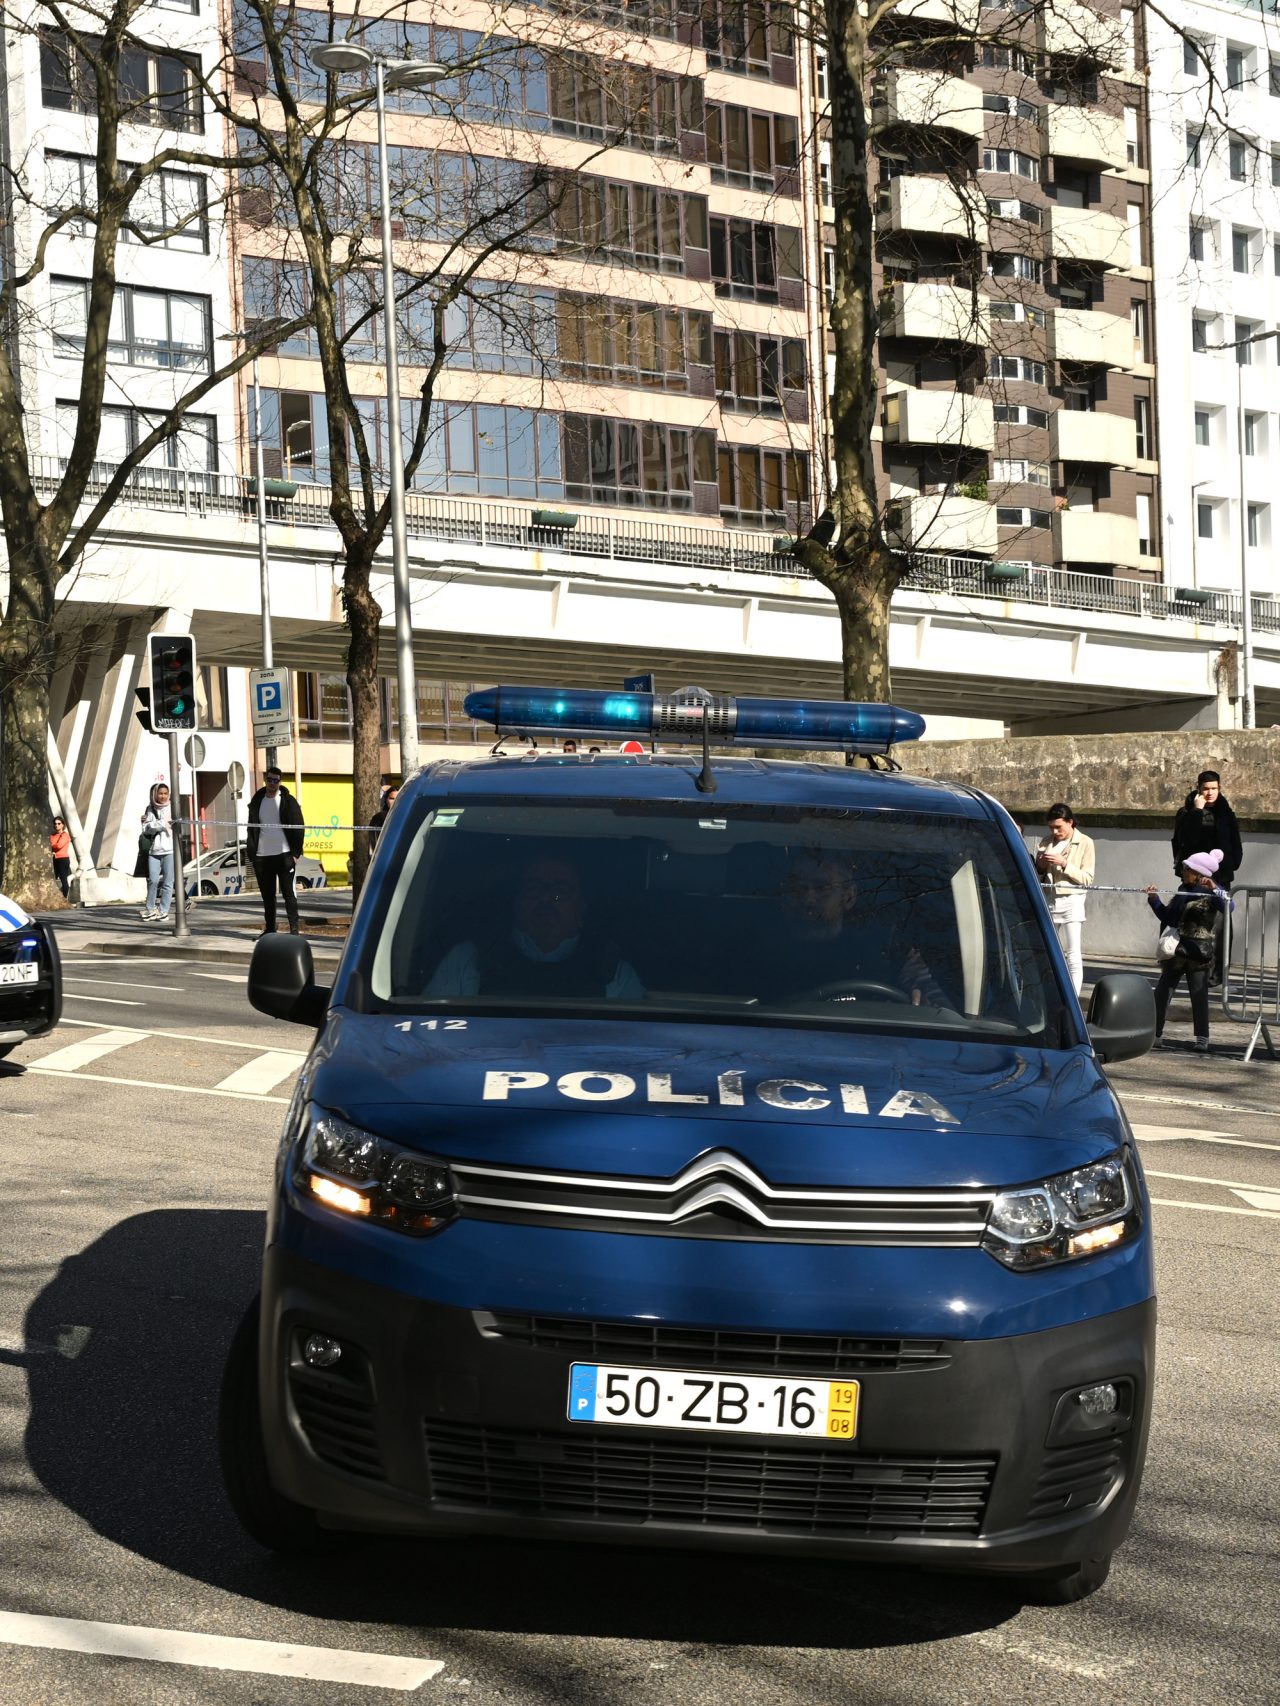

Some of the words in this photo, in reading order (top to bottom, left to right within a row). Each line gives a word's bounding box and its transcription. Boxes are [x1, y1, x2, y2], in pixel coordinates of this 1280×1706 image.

[261, 686, 276, 708] P
[304, 841, 334, 849] XPRESS
[393, 1019, 468, 1032] 112
[482, 1070, 962, 1124] POLÍCIA
[835, 1389, 852, 1404] 19
[578, 1399, 589, 1410] P
[830, 1418, 850, 1433] 08
